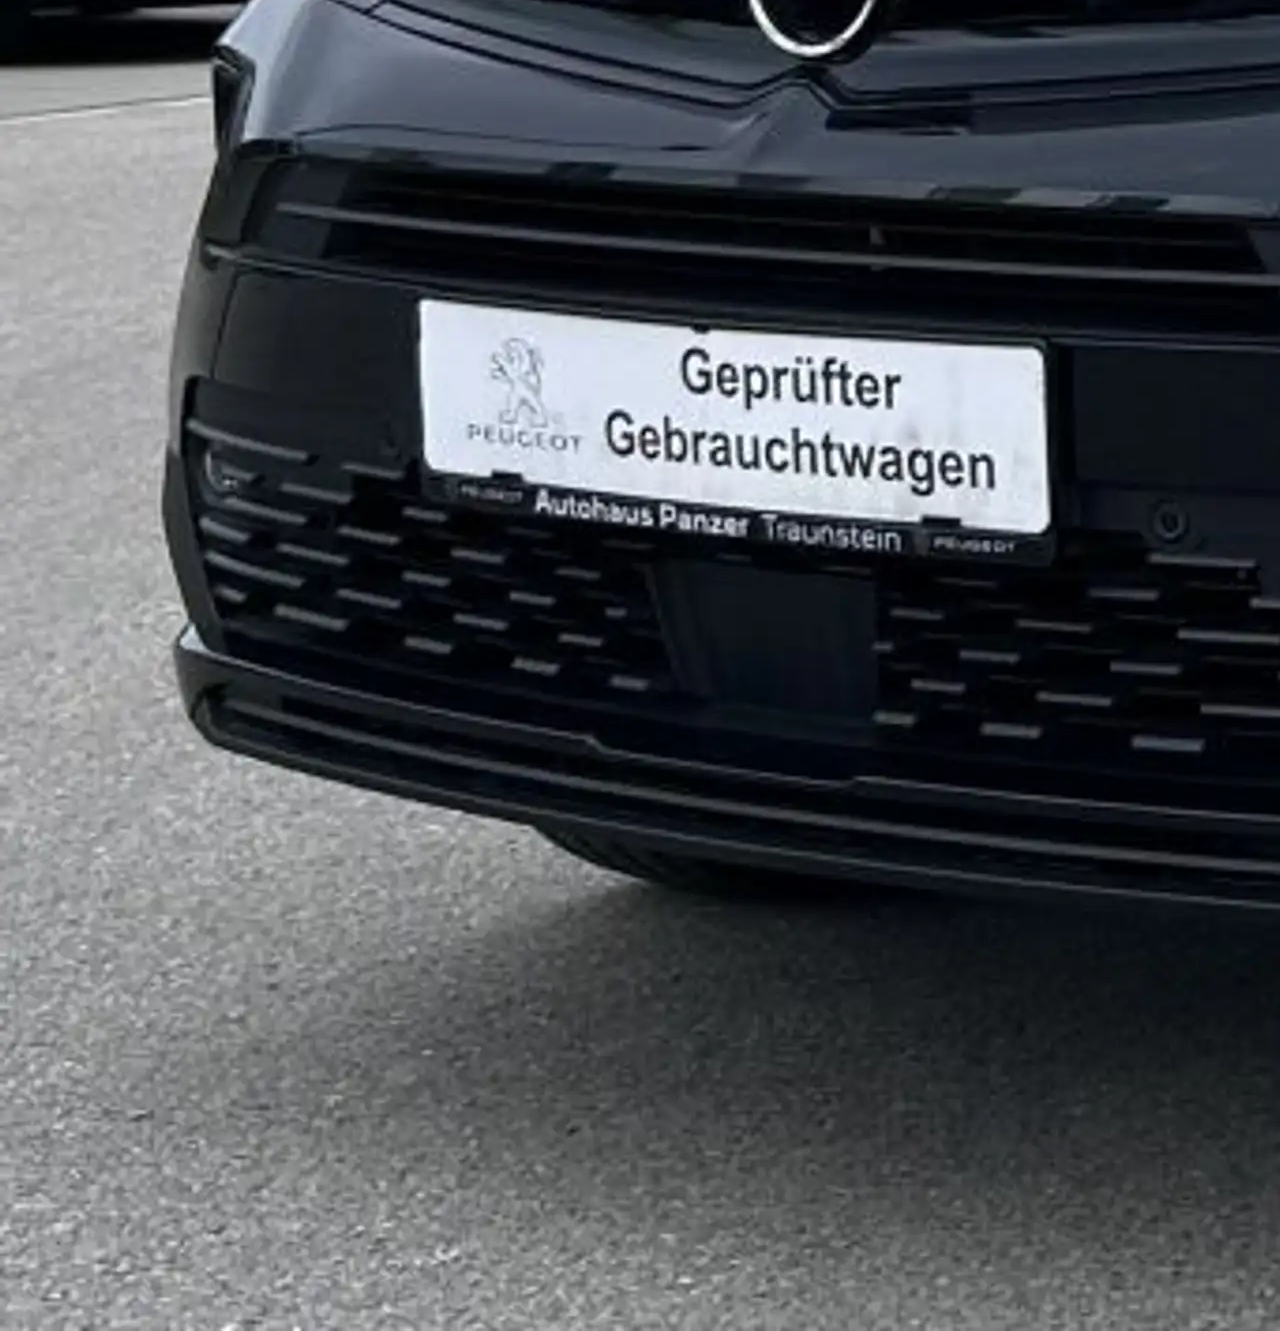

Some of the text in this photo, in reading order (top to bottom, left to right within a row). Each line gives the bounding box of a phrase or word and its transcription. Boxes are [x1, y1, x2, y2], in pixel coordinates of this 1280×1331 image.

[680, 346, 902, 411] Geprüfter
[466, 422, 583, 454] PEUGEOT
[604, 409, 997, 497] Gebrauchtwagen
[535, 487, 654, 527] Autohaus
[659, 502, 750, 537] Panzer
[760, 513, 902, 553] Traunstein
